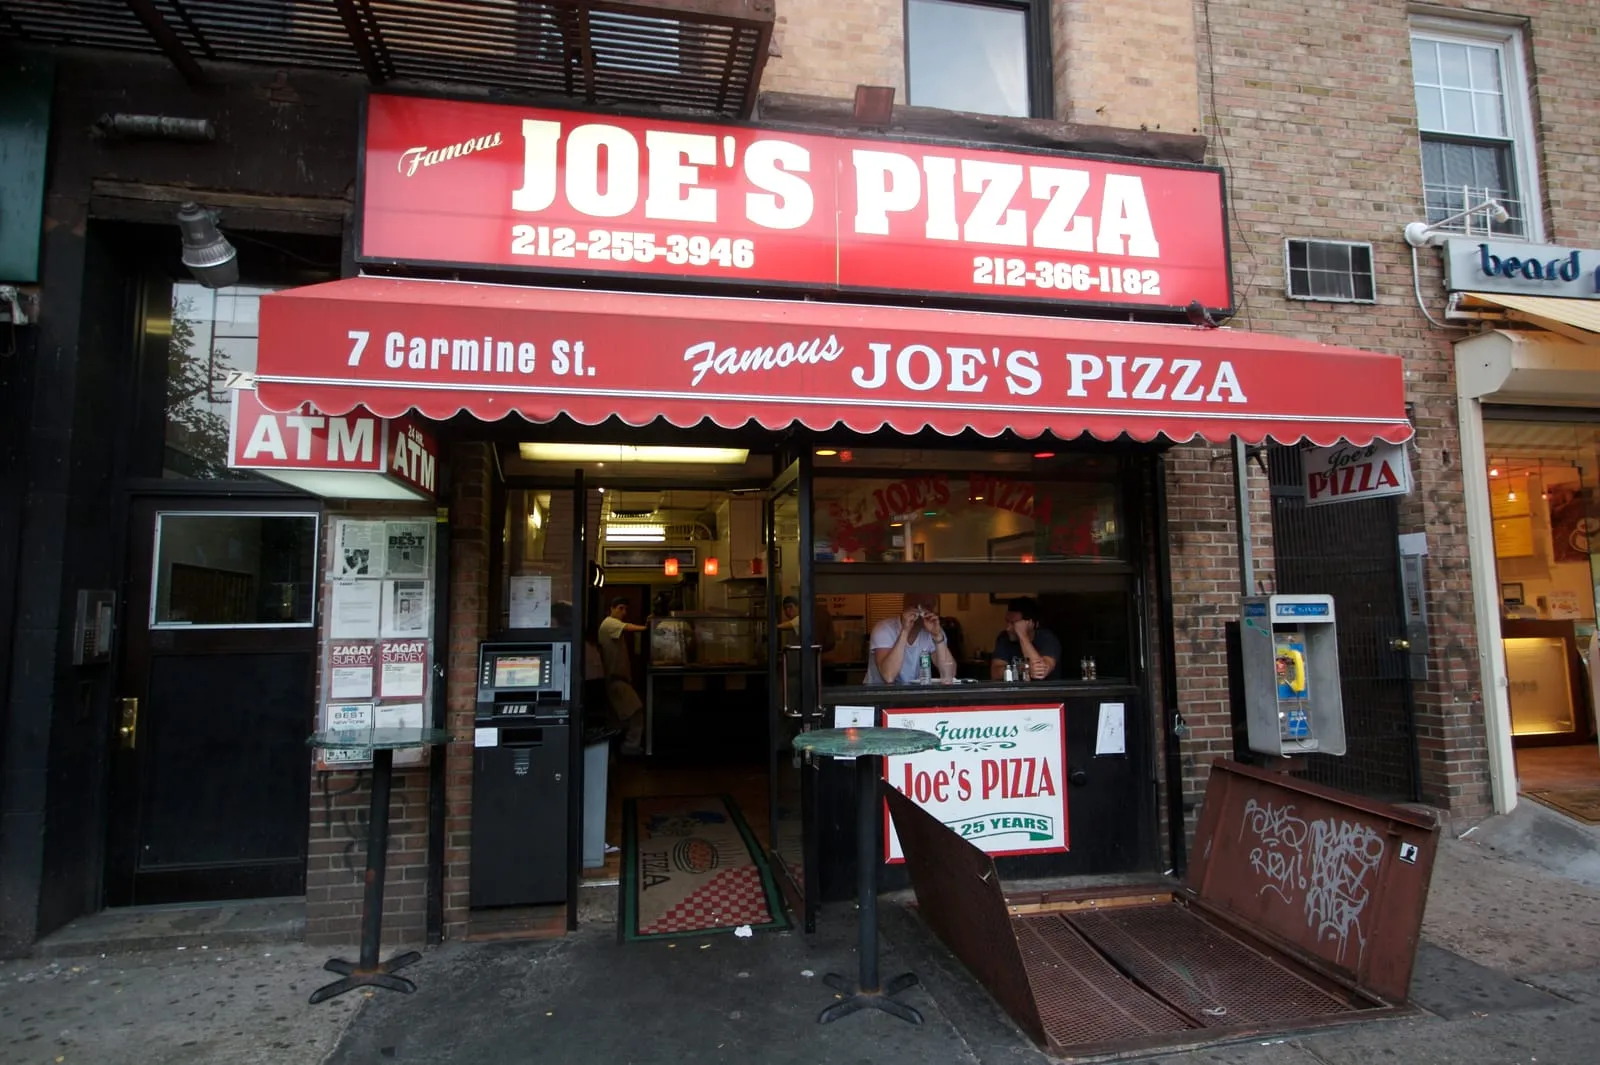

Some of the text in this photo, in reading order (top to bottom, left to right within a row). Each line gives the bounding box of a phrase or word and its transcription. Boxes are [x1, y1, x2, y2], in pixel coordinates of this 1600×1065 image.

[397, 118, 1160, 258] Famous JOE'S PIZZA
[511, 223, 755, 269] 212-255-3946
[1477, 243, 1581, 282] beard
[973, 256, 1161, 296] 212-366-1182
[347, 330, 597, 377] 7 Carmine St.
[683, 333, 1248, 403] Famous JOE'S PIZZA
[242, 414, 374, 463] ATM
[392, 431, 436, 493] ATM
[1308, 460, 1400, 499] PIZZA
[331, 655, 374, 665] SURVEY
[333, 646, 374, 656] ZAGAT
[382, 643, 425, 653] ZAGAT
[382, 652, 425, 662] SURVEY
[935, 720, 1019, 741] Famous
[895, 757, 1056, 804] Joe's PIZZA
[960, 820, 985, 836] 25
[990, 817, 1049, 831] YEARS
